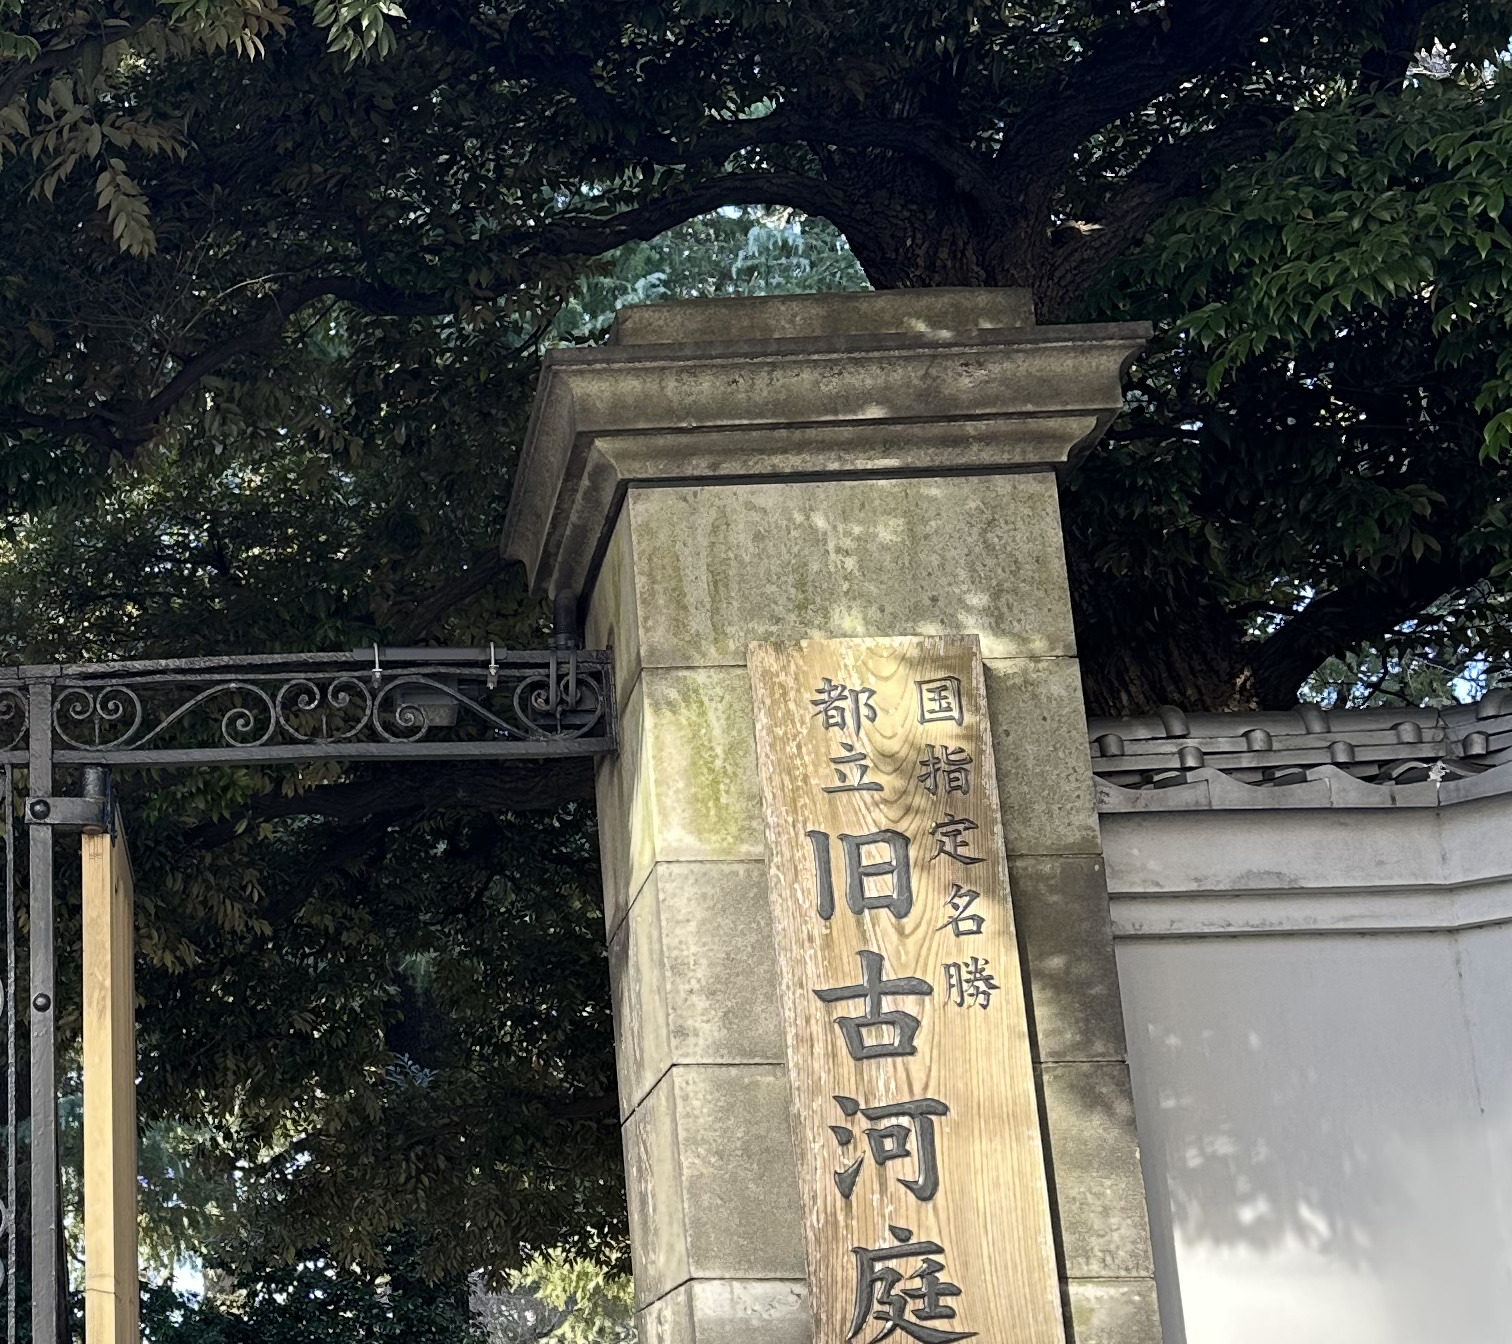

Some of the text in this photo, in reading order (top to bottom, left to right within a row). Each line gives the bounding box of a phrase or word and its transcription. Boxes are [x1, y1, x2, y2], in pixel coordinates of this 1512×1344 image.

[915, 675, 1000, 1011] 国指定名勝
